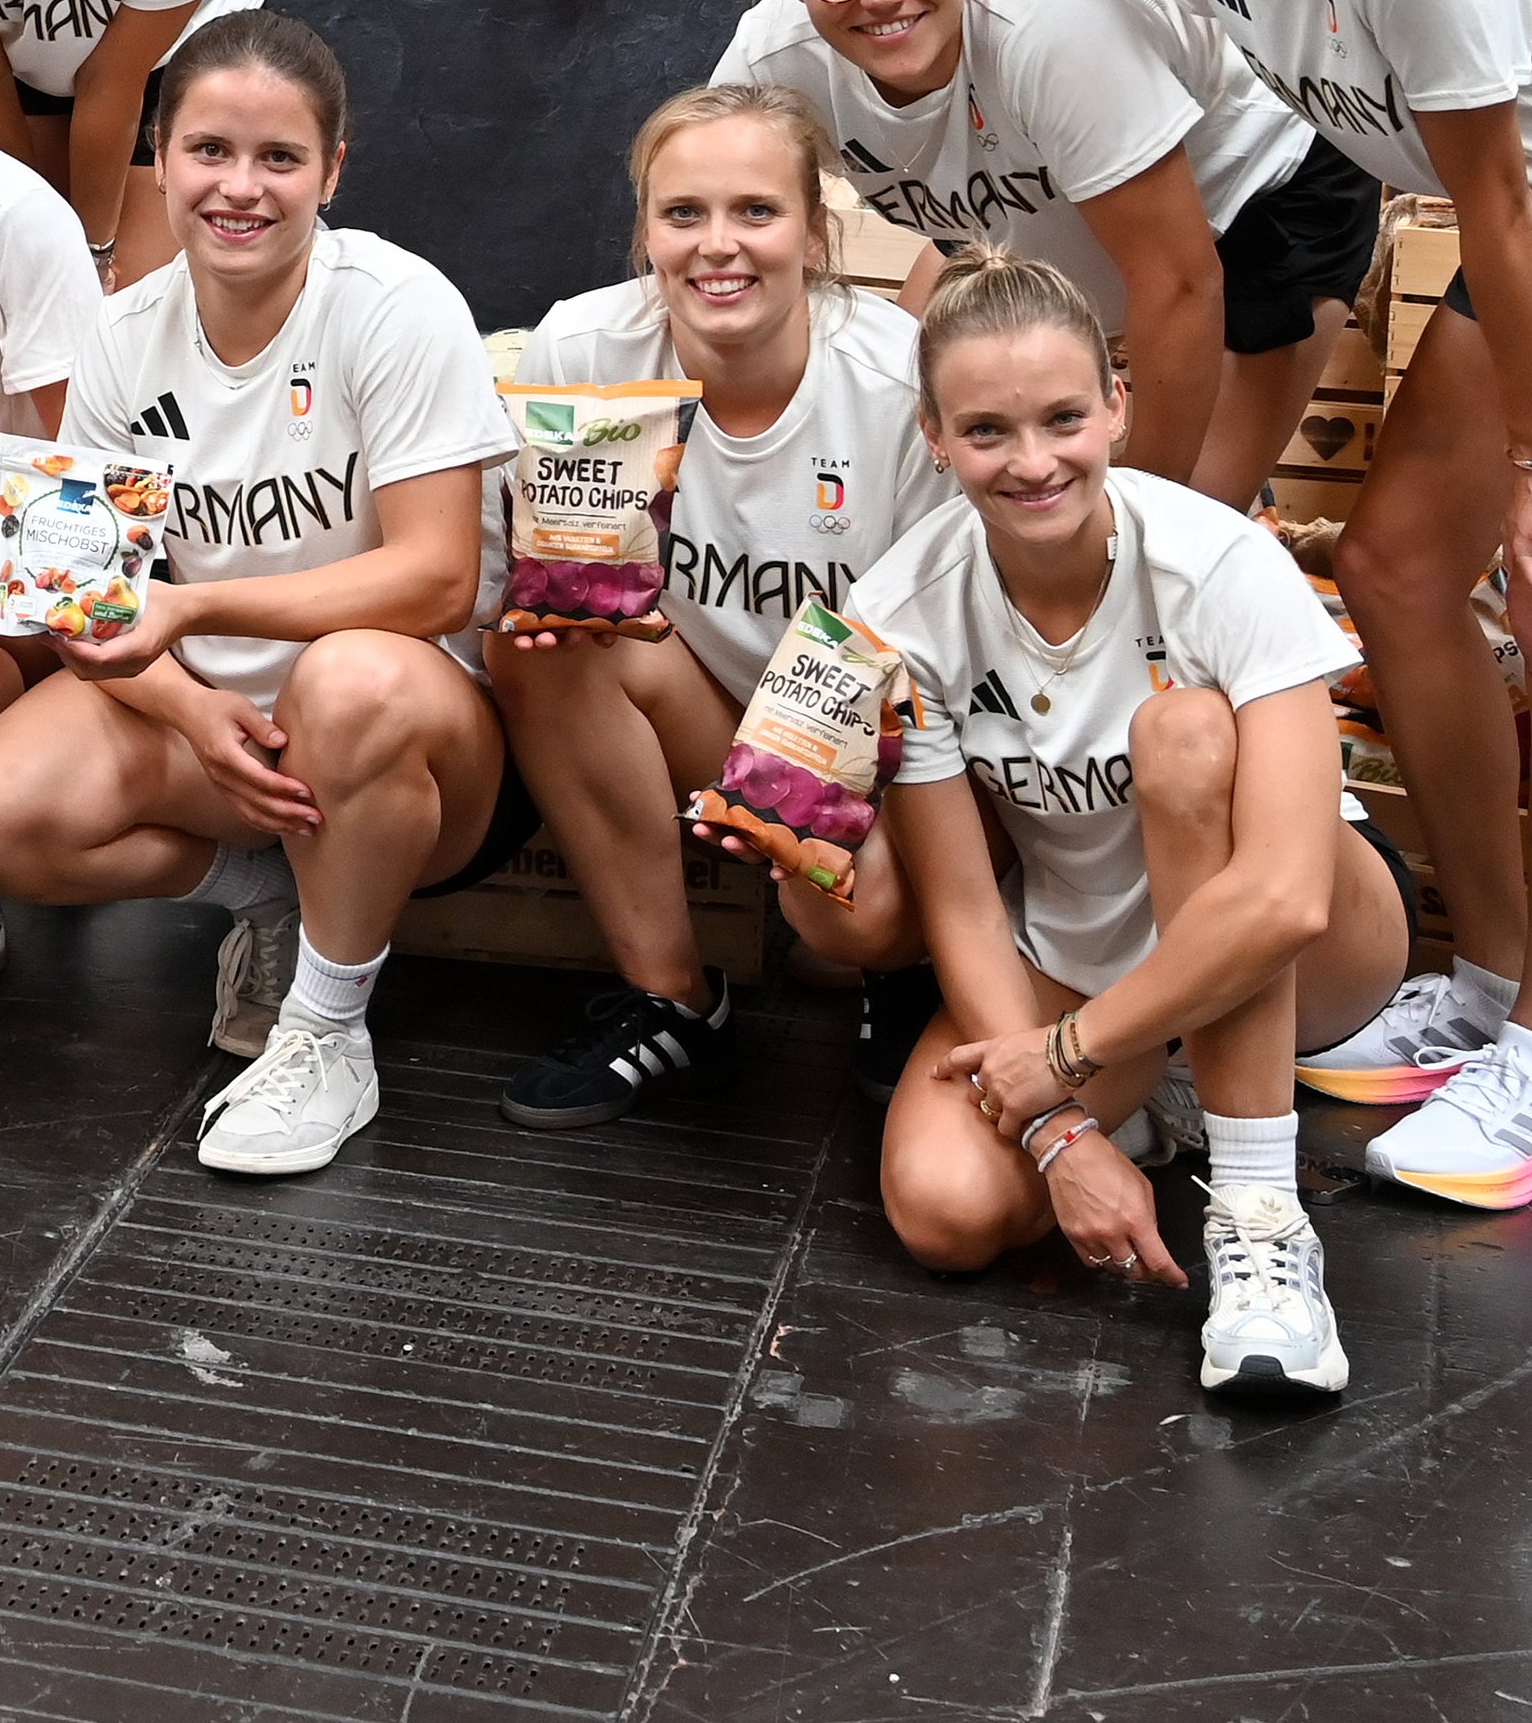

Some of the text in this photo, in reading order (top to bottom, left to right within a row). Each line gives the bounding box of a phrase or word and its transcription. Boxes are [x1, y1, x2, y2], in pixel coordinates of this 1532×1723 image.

[865, 165, 1057, 232] ERMANY
[291, 361, 316, 373] EAM
[578, 417, 642, 447] Bio
[537, 456, 623, 486] SWEET
[811, 456, 851, 469] TEAM
[521, 480, 648, 511] POTATO CHIPS
[30, 515, 107, 538] FRUCHTIGES
[26, 530, 110, 555] MISCHOBST
[796, 621, 840, 650] EDEKA
[1136, 636, 1167, 648] TEA
[760, 670, 822, 709] POTATO
[791, 653, 872, 705] SWEET
